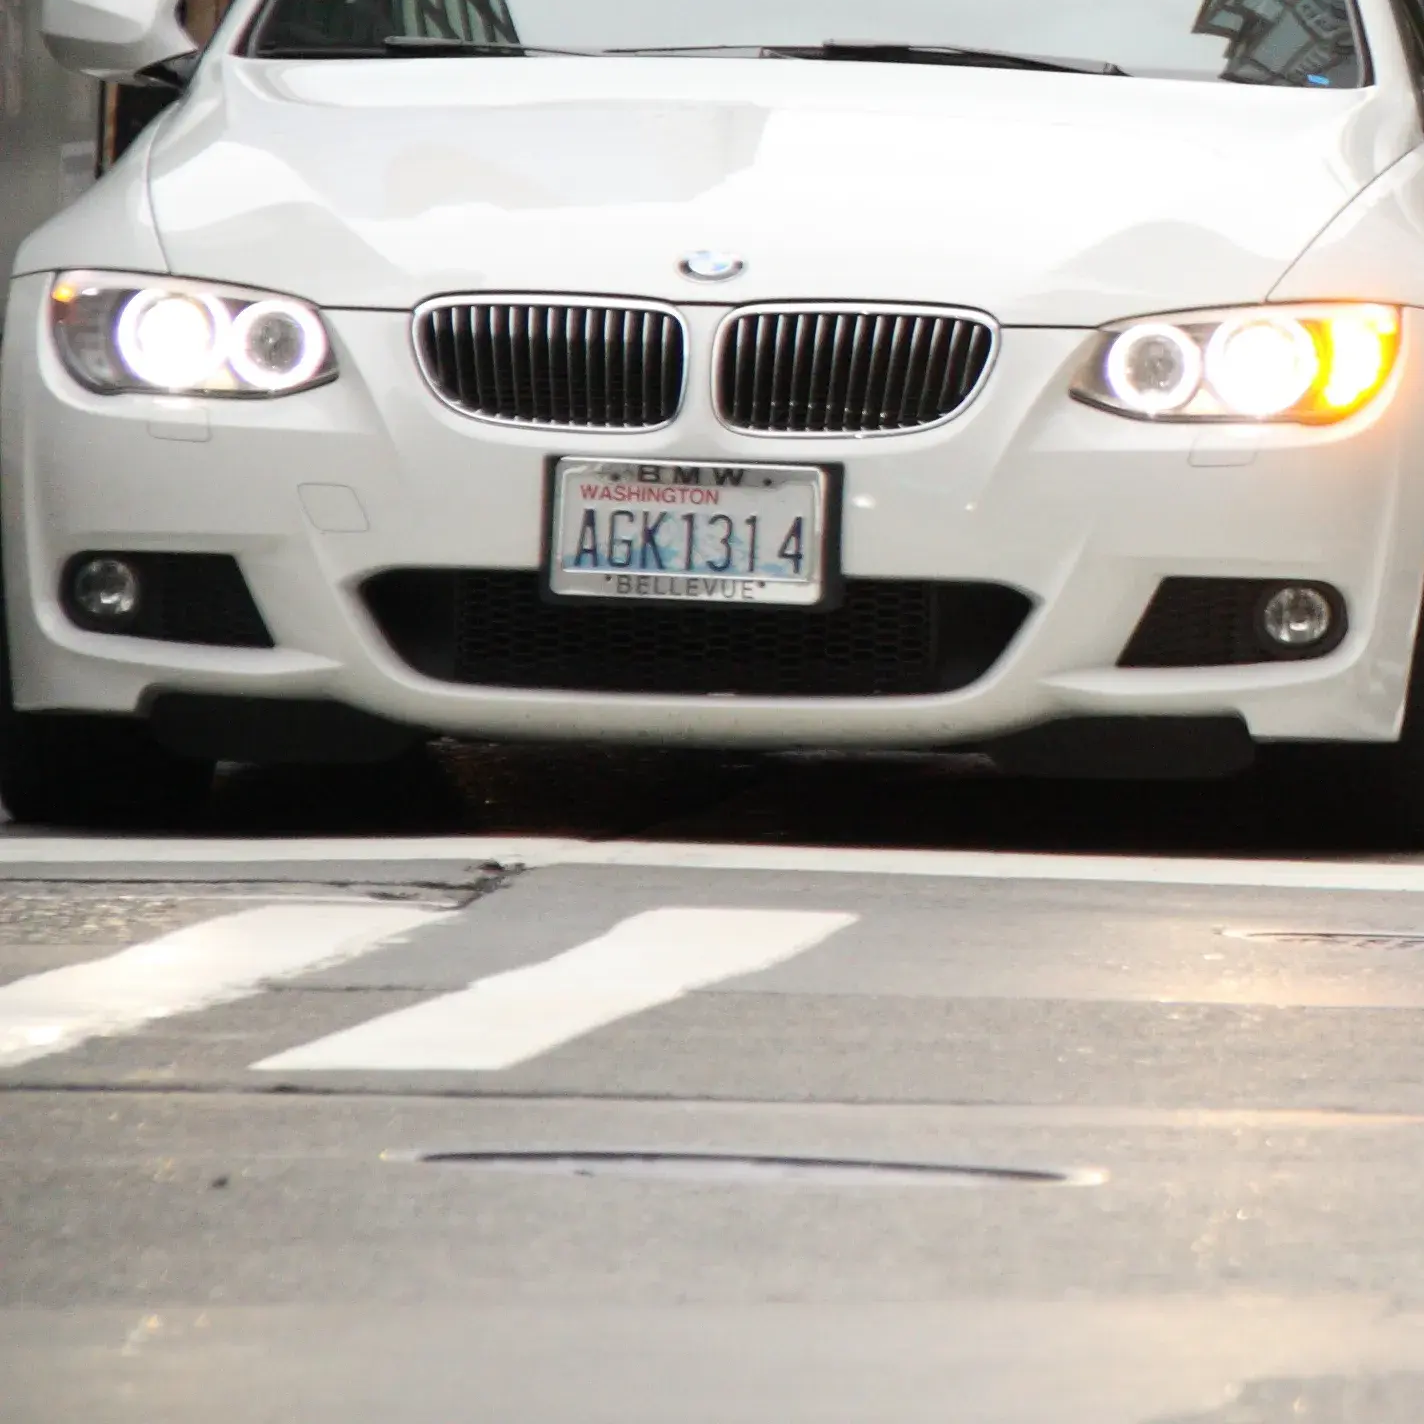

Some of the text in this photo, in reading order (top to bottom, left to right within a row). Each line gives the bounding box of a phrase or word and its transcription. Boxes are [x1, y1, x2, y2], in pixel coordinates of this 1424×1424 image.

[637, 464, 745, 486] BMW
[581, 484, 719, 505] WASHINGTON
[574, 508, 804, 574] AGK1314
[616, 574, 755, 600] BELLEVUE
